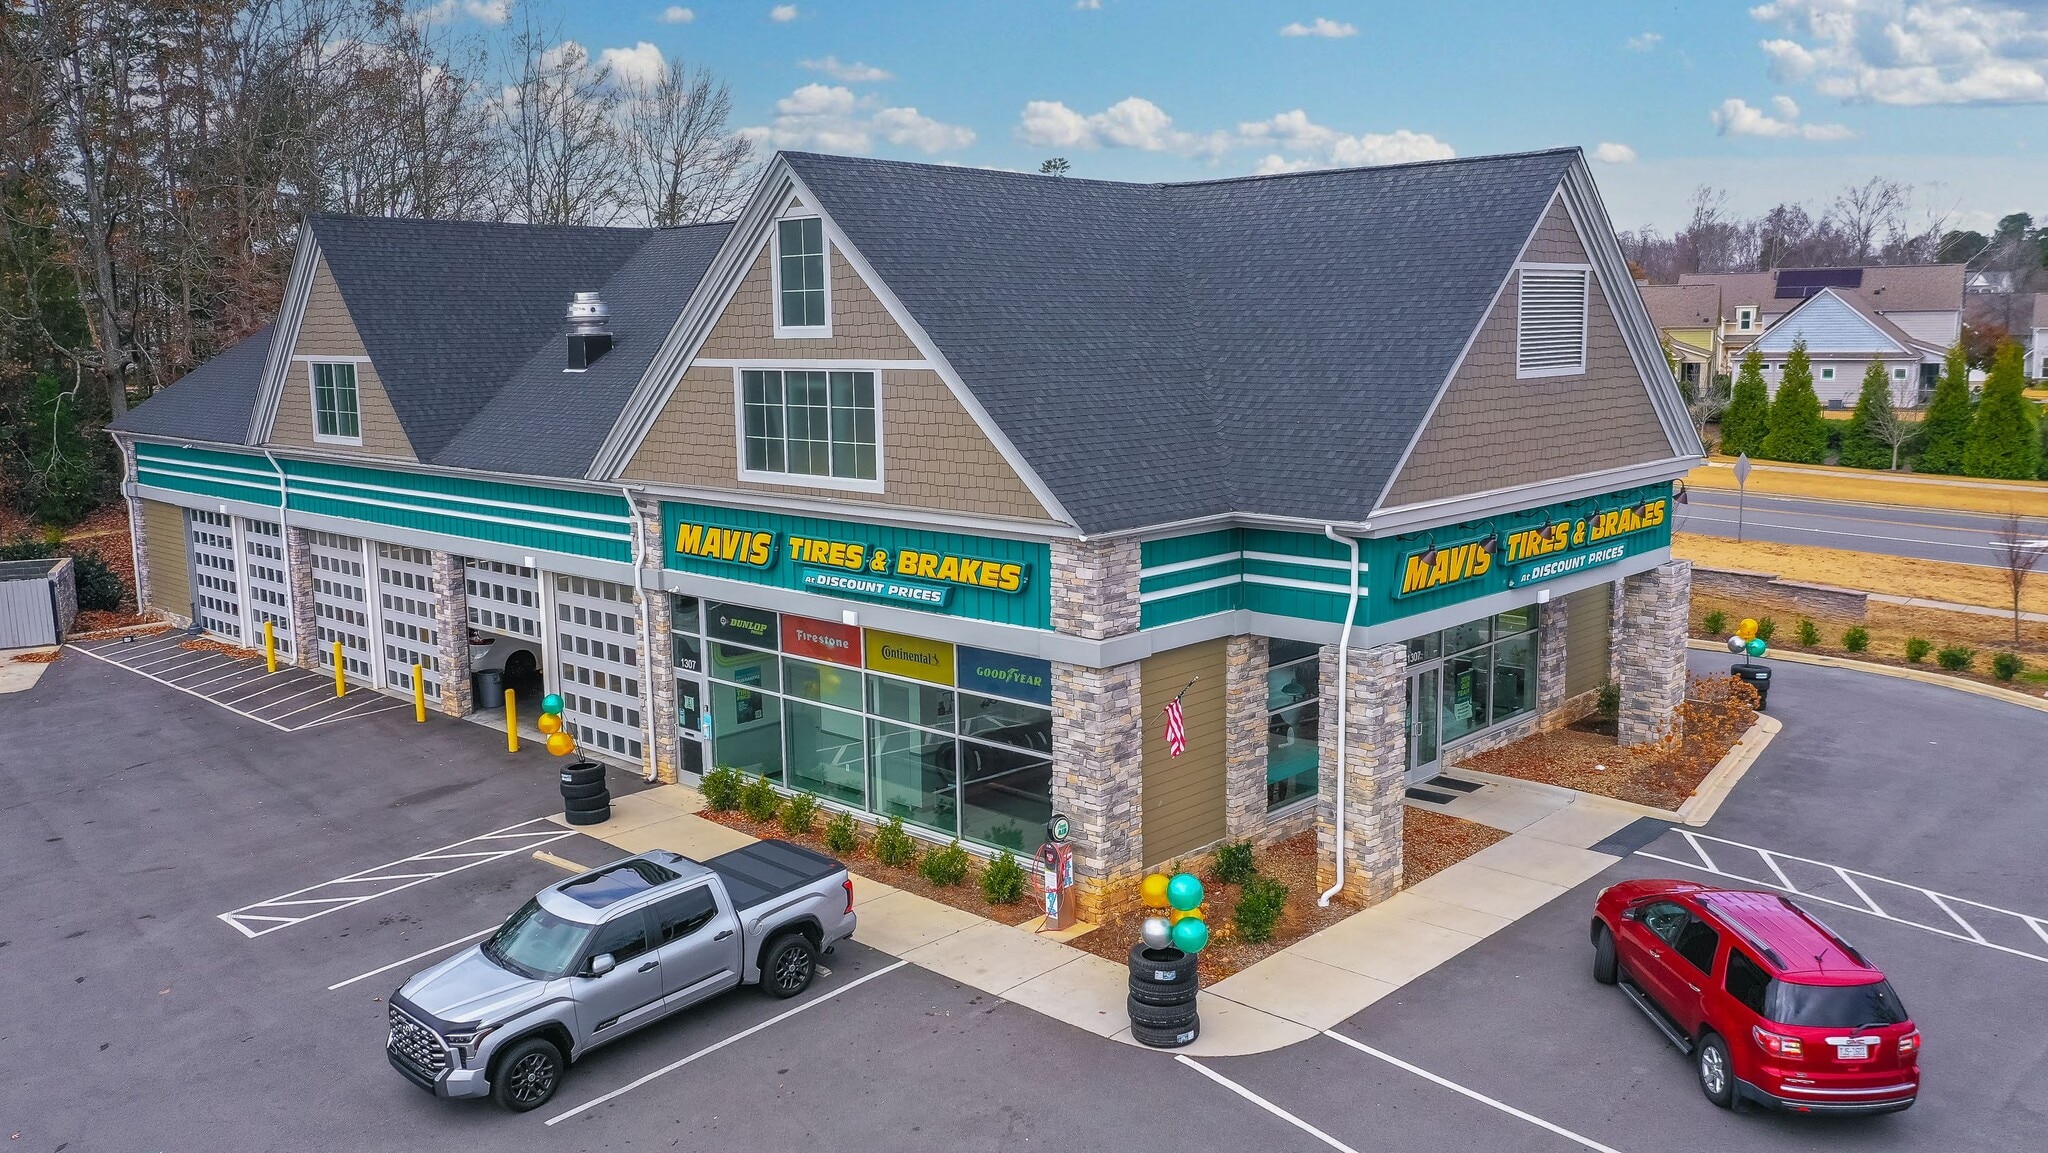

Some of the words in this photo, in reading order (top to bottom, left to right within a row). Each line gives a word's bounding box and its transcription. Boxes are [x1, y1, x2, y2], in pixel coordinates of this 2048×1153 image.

[676, 523, 772, 566] MAVIS
[789, 536, 864, 570] TIRES
[869, 550, 887, 572] &
[897, 550, 1022, 592] BRAKES
[1402, 542, 1491, 594] MAVIS
[1507, 522, 1569, 563] TIRES
[1573, 521, 1586, 544] &
[1532, 555, 1586, 579] DISCOUNT
[1588, 545, 1625, 564] PRICES
[817, 575, 885, 594] DISCOUNT
[888, 585, 942, 602] PRICES
[730, 618, 768, 632] DUNLOP
[796, 629, 849, 649] Firestone
[680, 658, 697, 670] 1307
[881, 645, 932, 665] Continental
